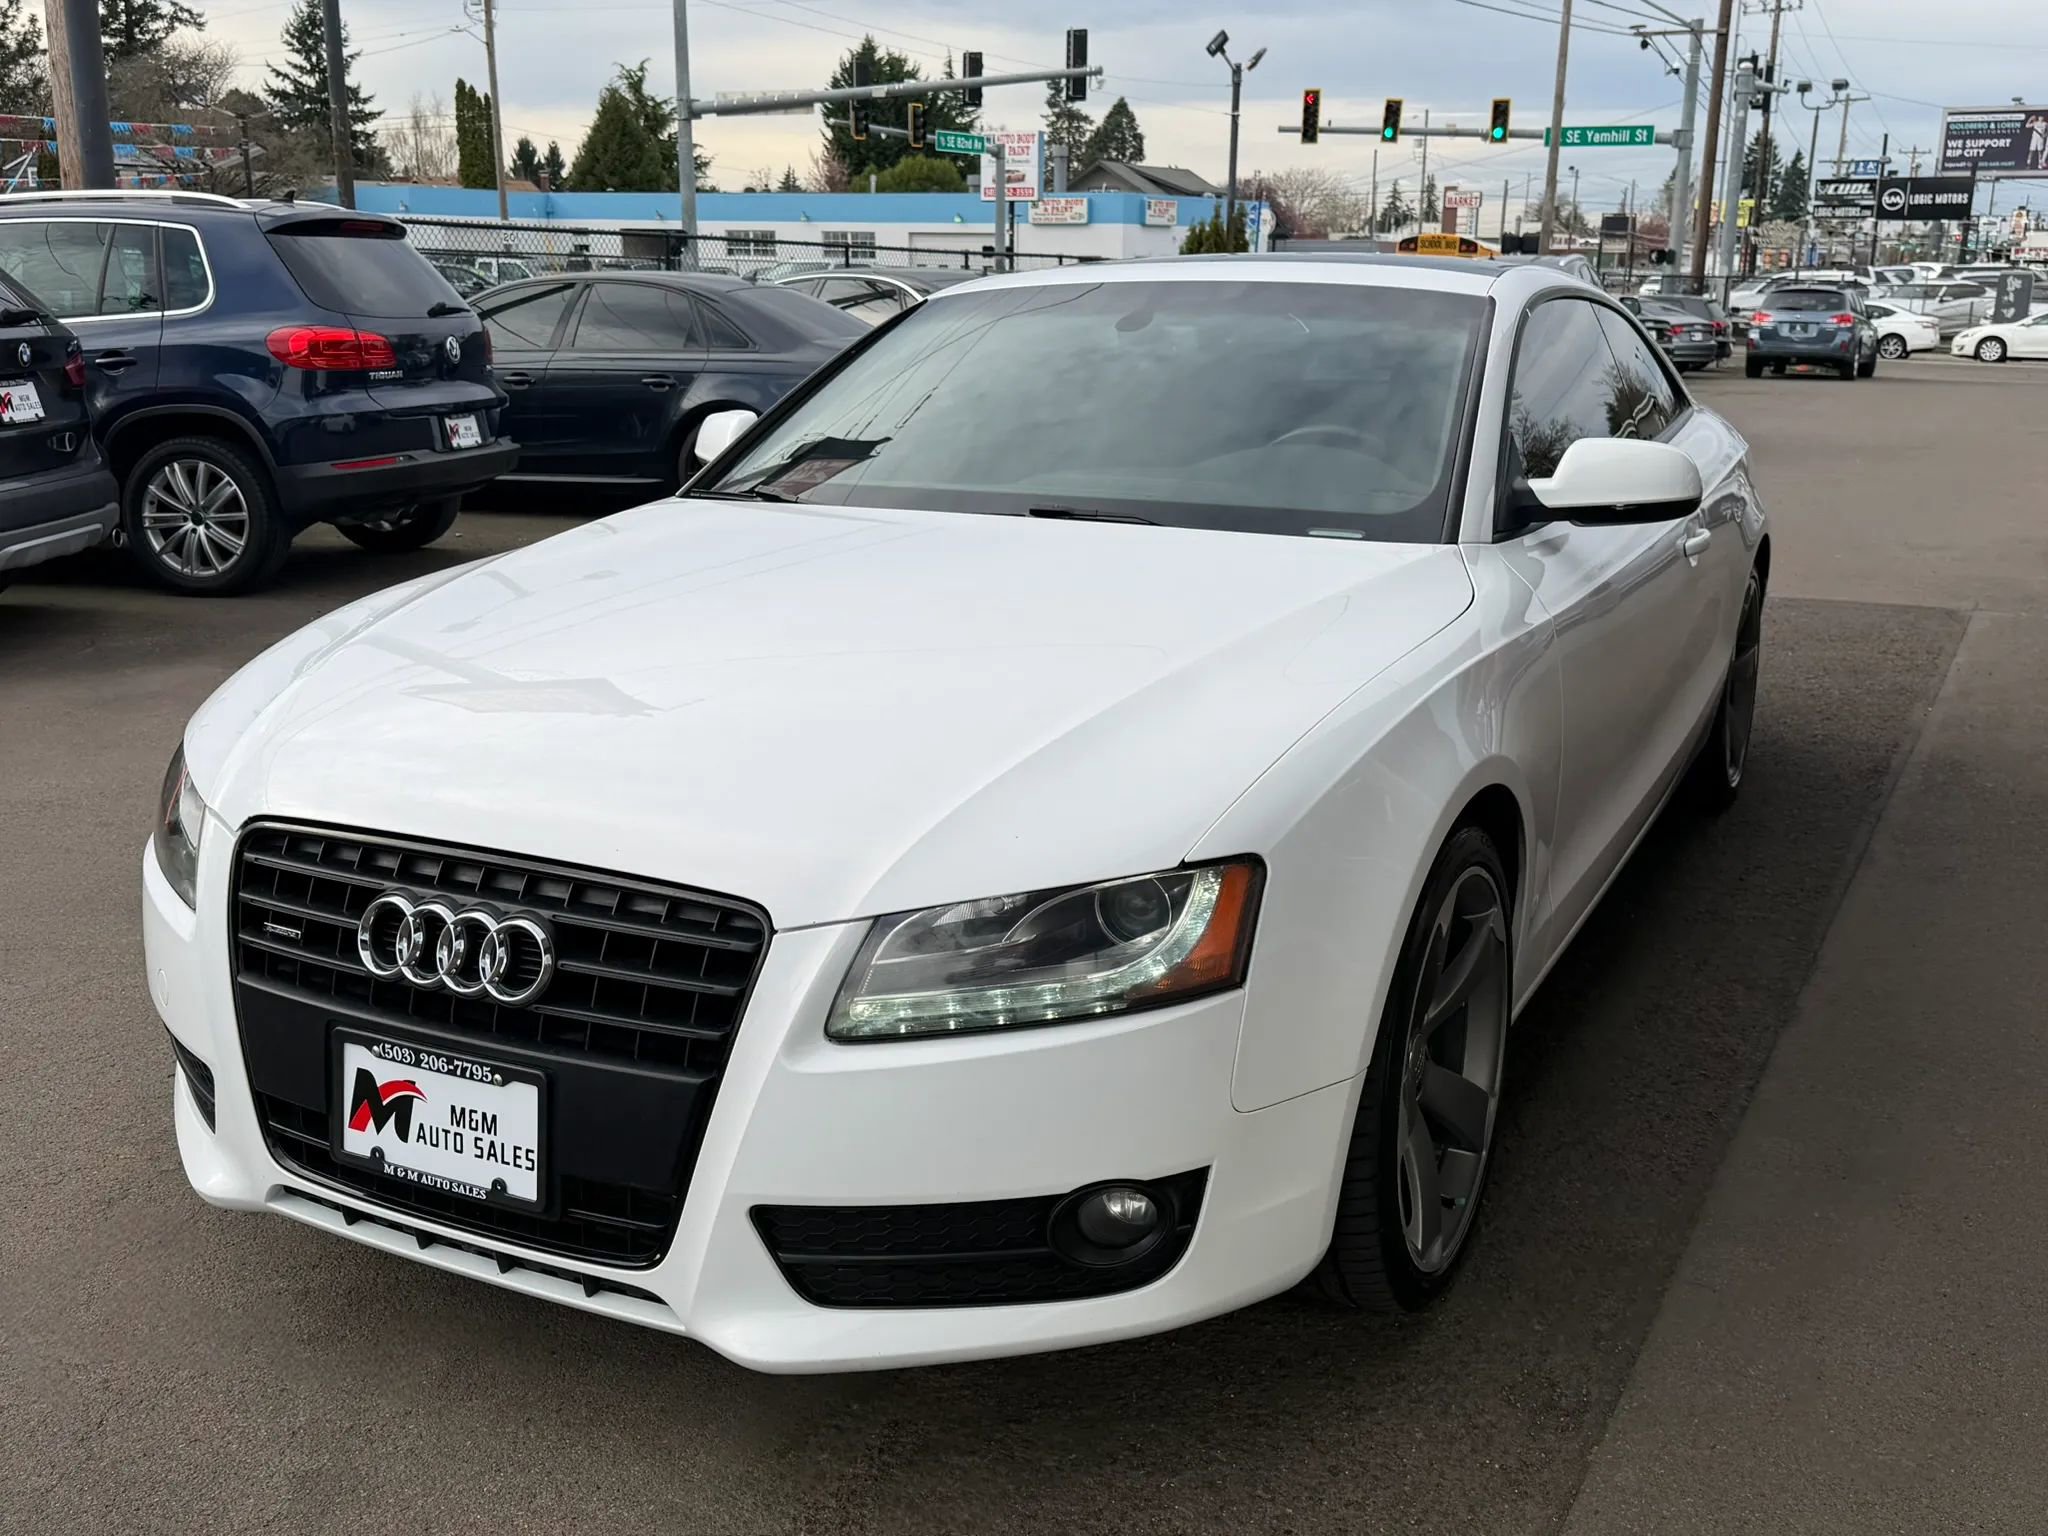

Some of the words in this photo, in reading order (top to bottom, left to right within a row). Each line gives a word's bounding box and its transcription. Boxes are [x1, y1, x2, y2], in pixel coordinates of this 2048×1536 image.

[997, 133, 1016, 144] AUTO
[1017, 133, 1036, 144] BODY
[1565, 130, 1581, 143] SE
[1586, 129, 1631, 143] Yamhill
[1634, 128, 1648, 142] St
[947, 135, 955, 148] SE
[957, 136, 973, 149] 82nd
[1947, 139, 1964, 148] WE
[1965, 138, 2012, 148] SUPPORT
[1008, 145, 1031, 156] PAINT
[1945, 149, 1963, 158] RIP
[1963, 148, 1986, 158] CITY
[1447, 196, 1479, 207] MARKET
[1909, 193, 1934, 205] LOGIC
[1935, 192, 1969, 205] MOTORS
[1420, 240, 1442, 250] SCHOOL
[1445, 240, 1457, 250] BUS
[368, 370, 404, 380] TIGUAN
[379, 1042, 416, 1065] (503)
[420, 1053, 493, 1083] 206-7795
[450, 1104, 498, 1137] M&M
[416, 1122, 464, 1154] AUTO
[474, 1137, 536, 1172] SALES
[384, 1163, 395, 1176] M
[397, 1166, 406, 1177] &
[407, 1169, 419, 1182] M
[420, 1174, 450, 1191] AUTO
[452, 1182, 487, 1200] SALES
